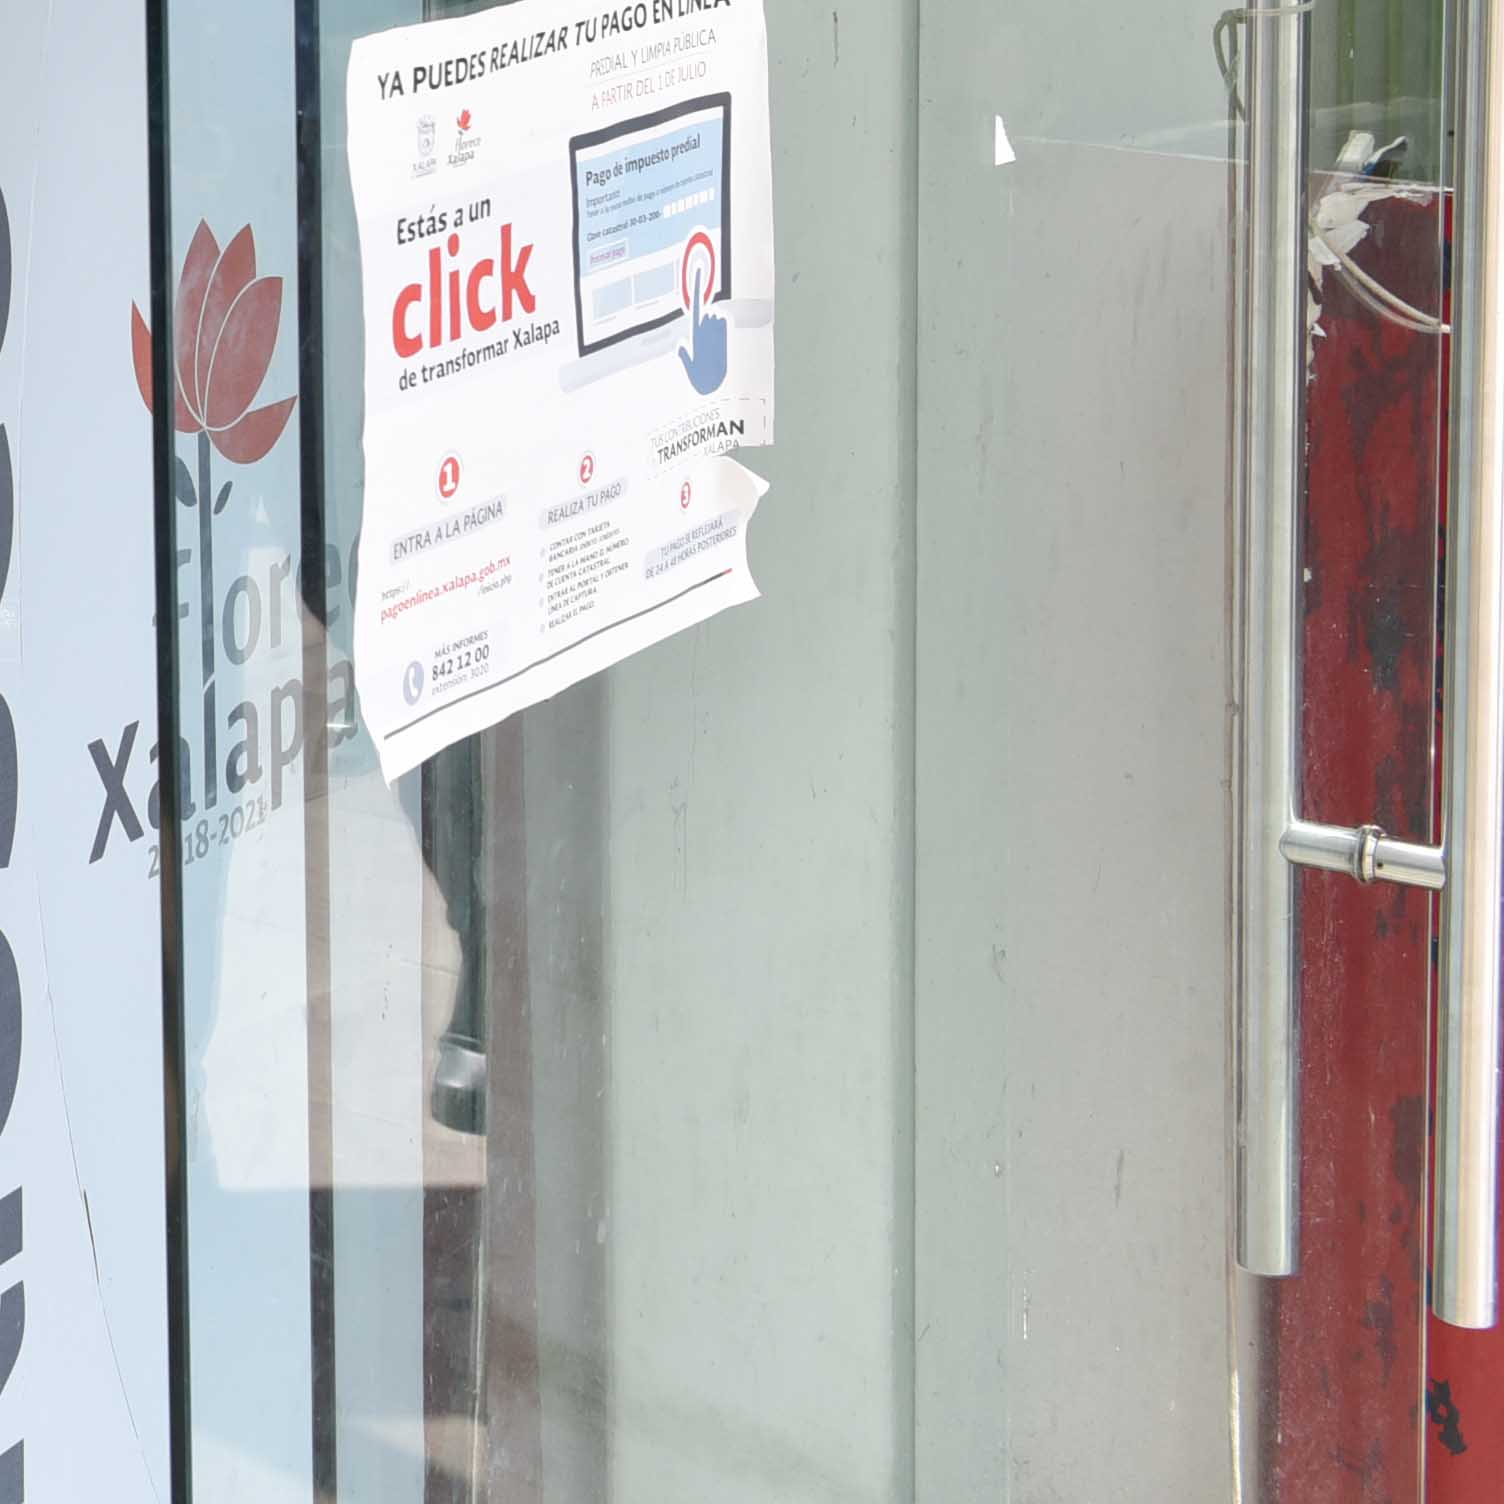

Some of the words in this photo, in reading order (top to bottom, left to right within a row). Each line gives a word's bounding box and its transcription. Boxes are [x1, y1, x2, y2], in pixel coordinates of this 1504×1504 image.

[377, 71, 404, 100] YA
[413, 51, 486, 93] PUEDES
[491, 26, 568, 73] REALIZAR
[575, 17, 597, 46] TU
[601, 3, 647, 39] PAGO
[586, 169, 611, 186] Pago
[613, 162, 623, 177] de
[625, 149, 669, 172] impuesto
[672, 134, 700, 161] predial
[396, 205, 447, 246] Estás
[454, 209, 463, 225] a
[469, 198, 491, 222] un
[393, 223, 536, 359] click
[399, 369, 418, 392] de
[421, 341, 509, 381] transformar
[513, 321, 560, 348] Xalapa
[657, 420, 744, 464] TRANSFORMAN
[393, 530, 432, 560] ENTRA
[463, 500, 503, 531] PÁGINA
[432, 658, 453, 681] 842
[457, 651, 472, 669] 12
[475, 644, 489, 662] 00
[148, 794, 267, 880] 218-2021
